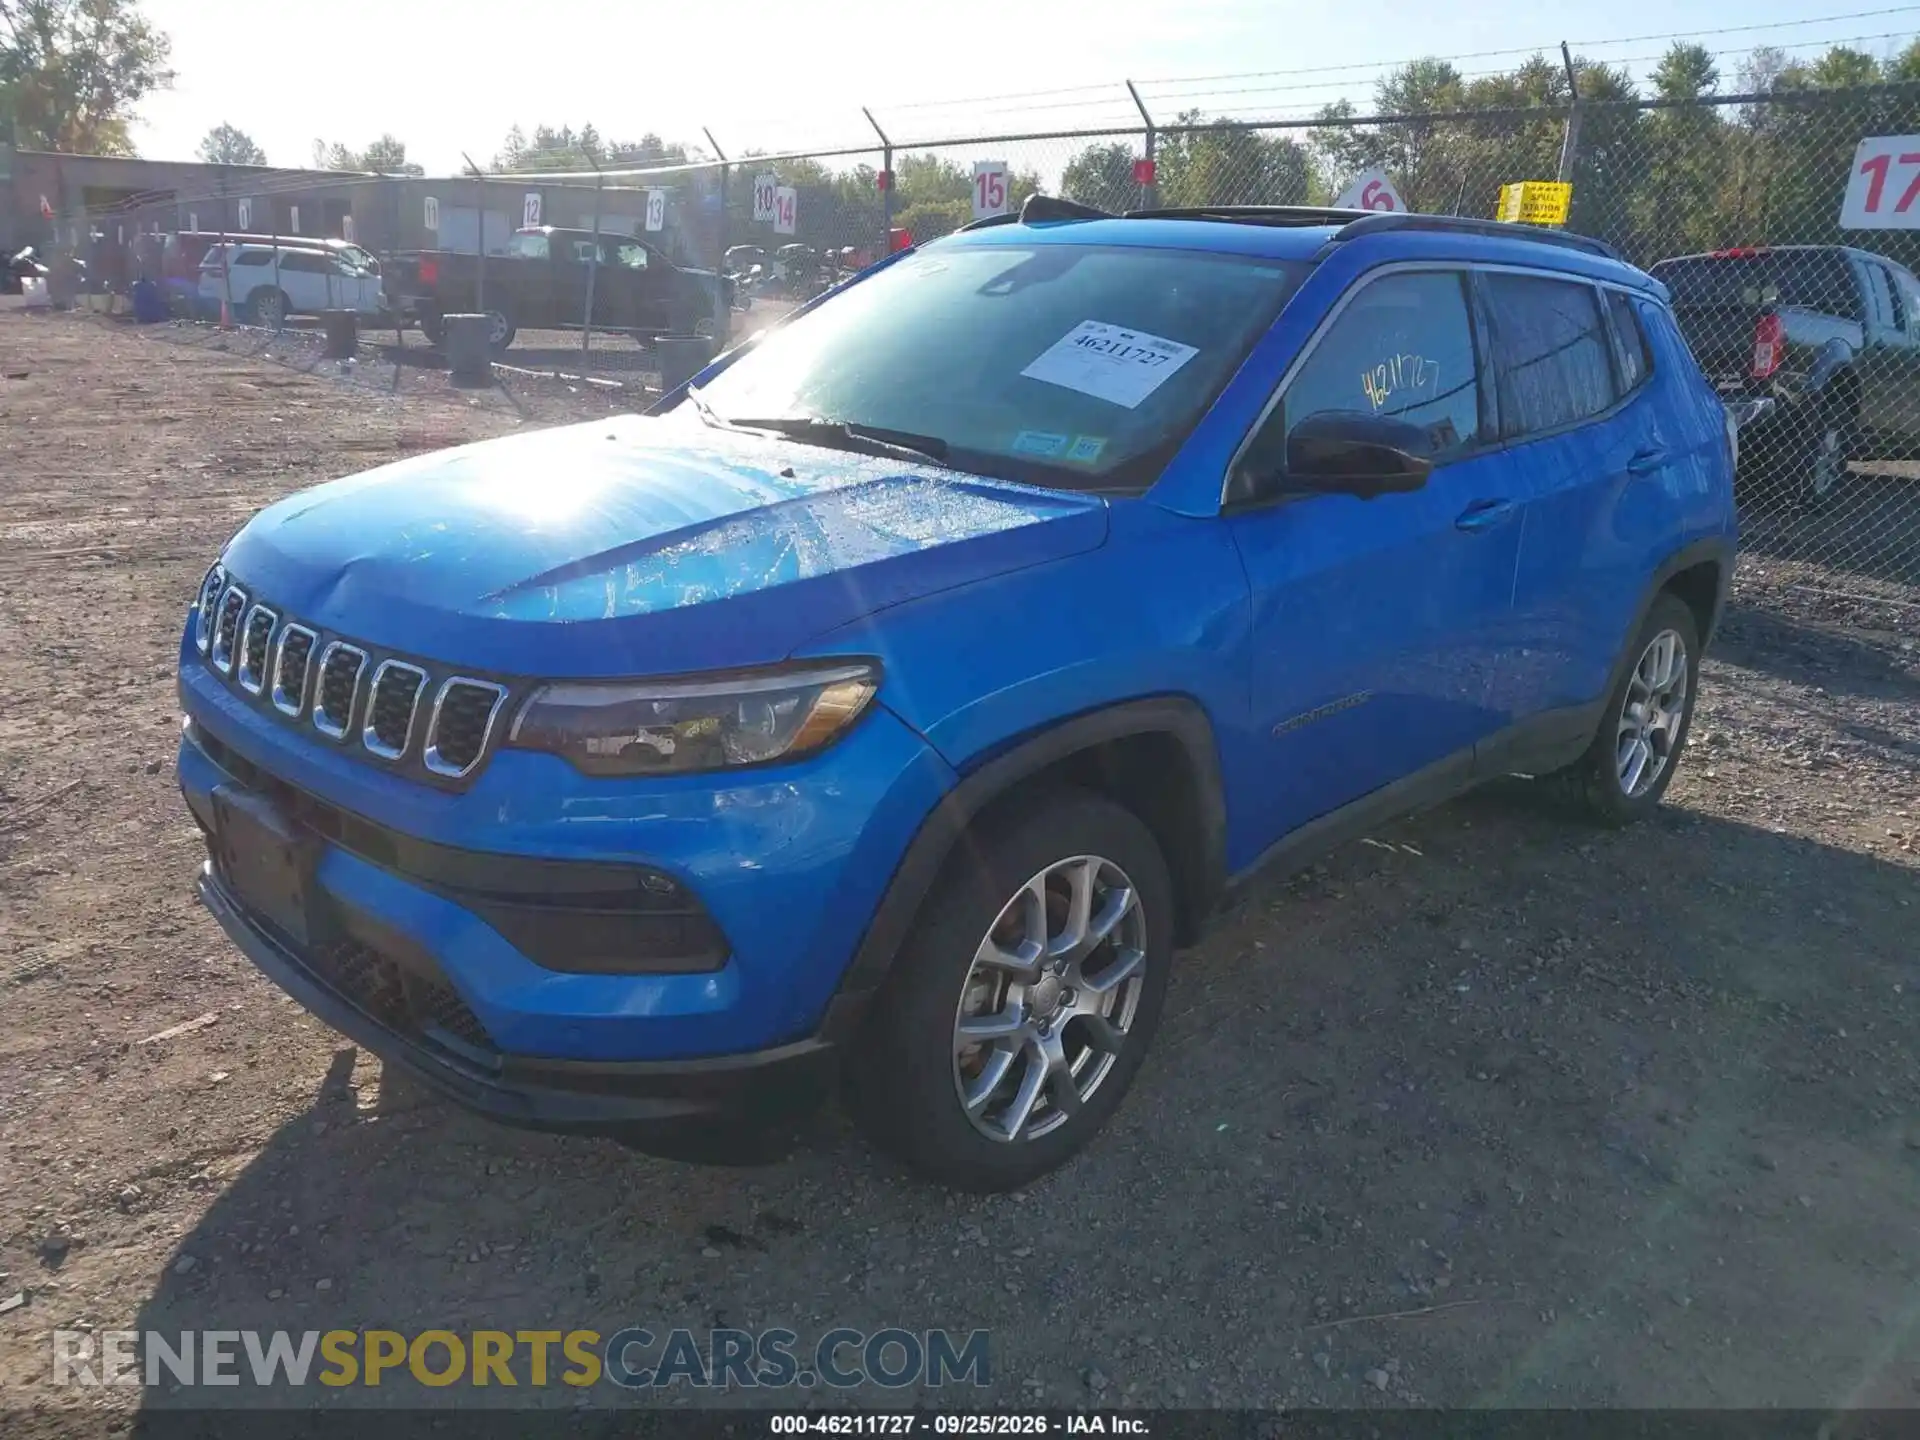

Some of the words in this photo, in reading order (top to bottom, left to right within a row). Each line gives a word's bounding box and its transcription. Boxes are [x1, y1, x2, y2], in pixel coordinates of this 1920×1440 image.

[976, 172, 1005, 209] 15
[1530, 193, 1557, 202] SPILL
[1860, 153, 1920, 213] 17
[526, 200, 539, 223] 12
[649, 198, 663, 226] 13
[757, 184, 773, 212] 10
[776, 195, 794, 226] 14
[1523, 203, 1560, 212] STATION
[1074, 335, 1170, 367] 46211727
[1361, 353, 1440, 411] 46211727
